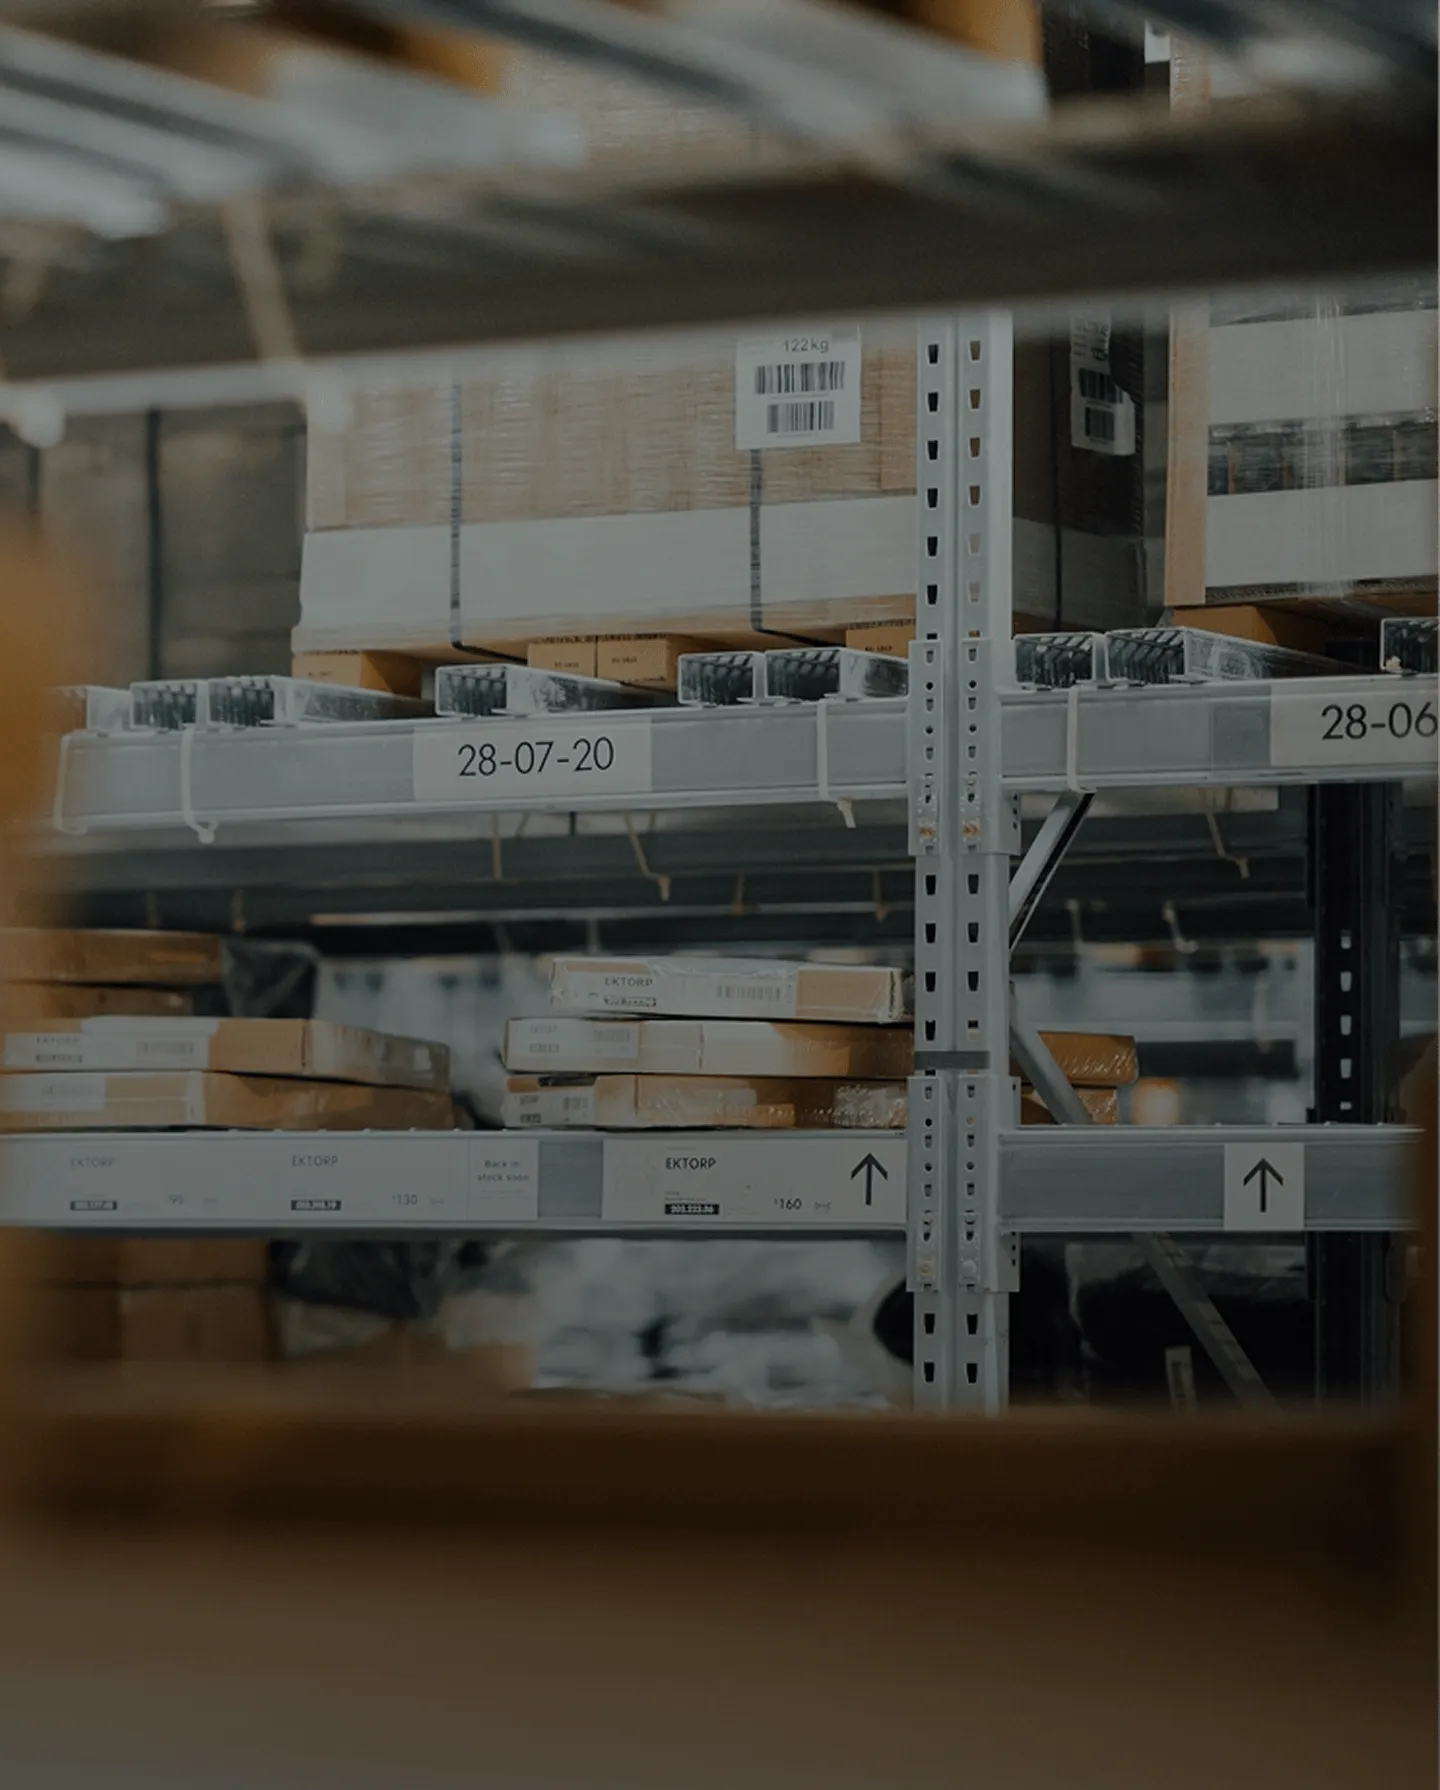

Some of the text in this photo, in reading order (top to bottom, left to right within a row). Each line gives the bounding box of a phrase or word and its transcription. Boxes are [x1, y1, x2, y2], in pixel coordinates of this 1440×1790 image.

[784, 338, 829, 353] 122kg
[1321, 702, 1438, 740] 28-06
[457, 737, 614, 776] 28-07-20
[291, 1155, 338, 1167] EKTORP
[665, 1157, 716, 1170] EKTORP
